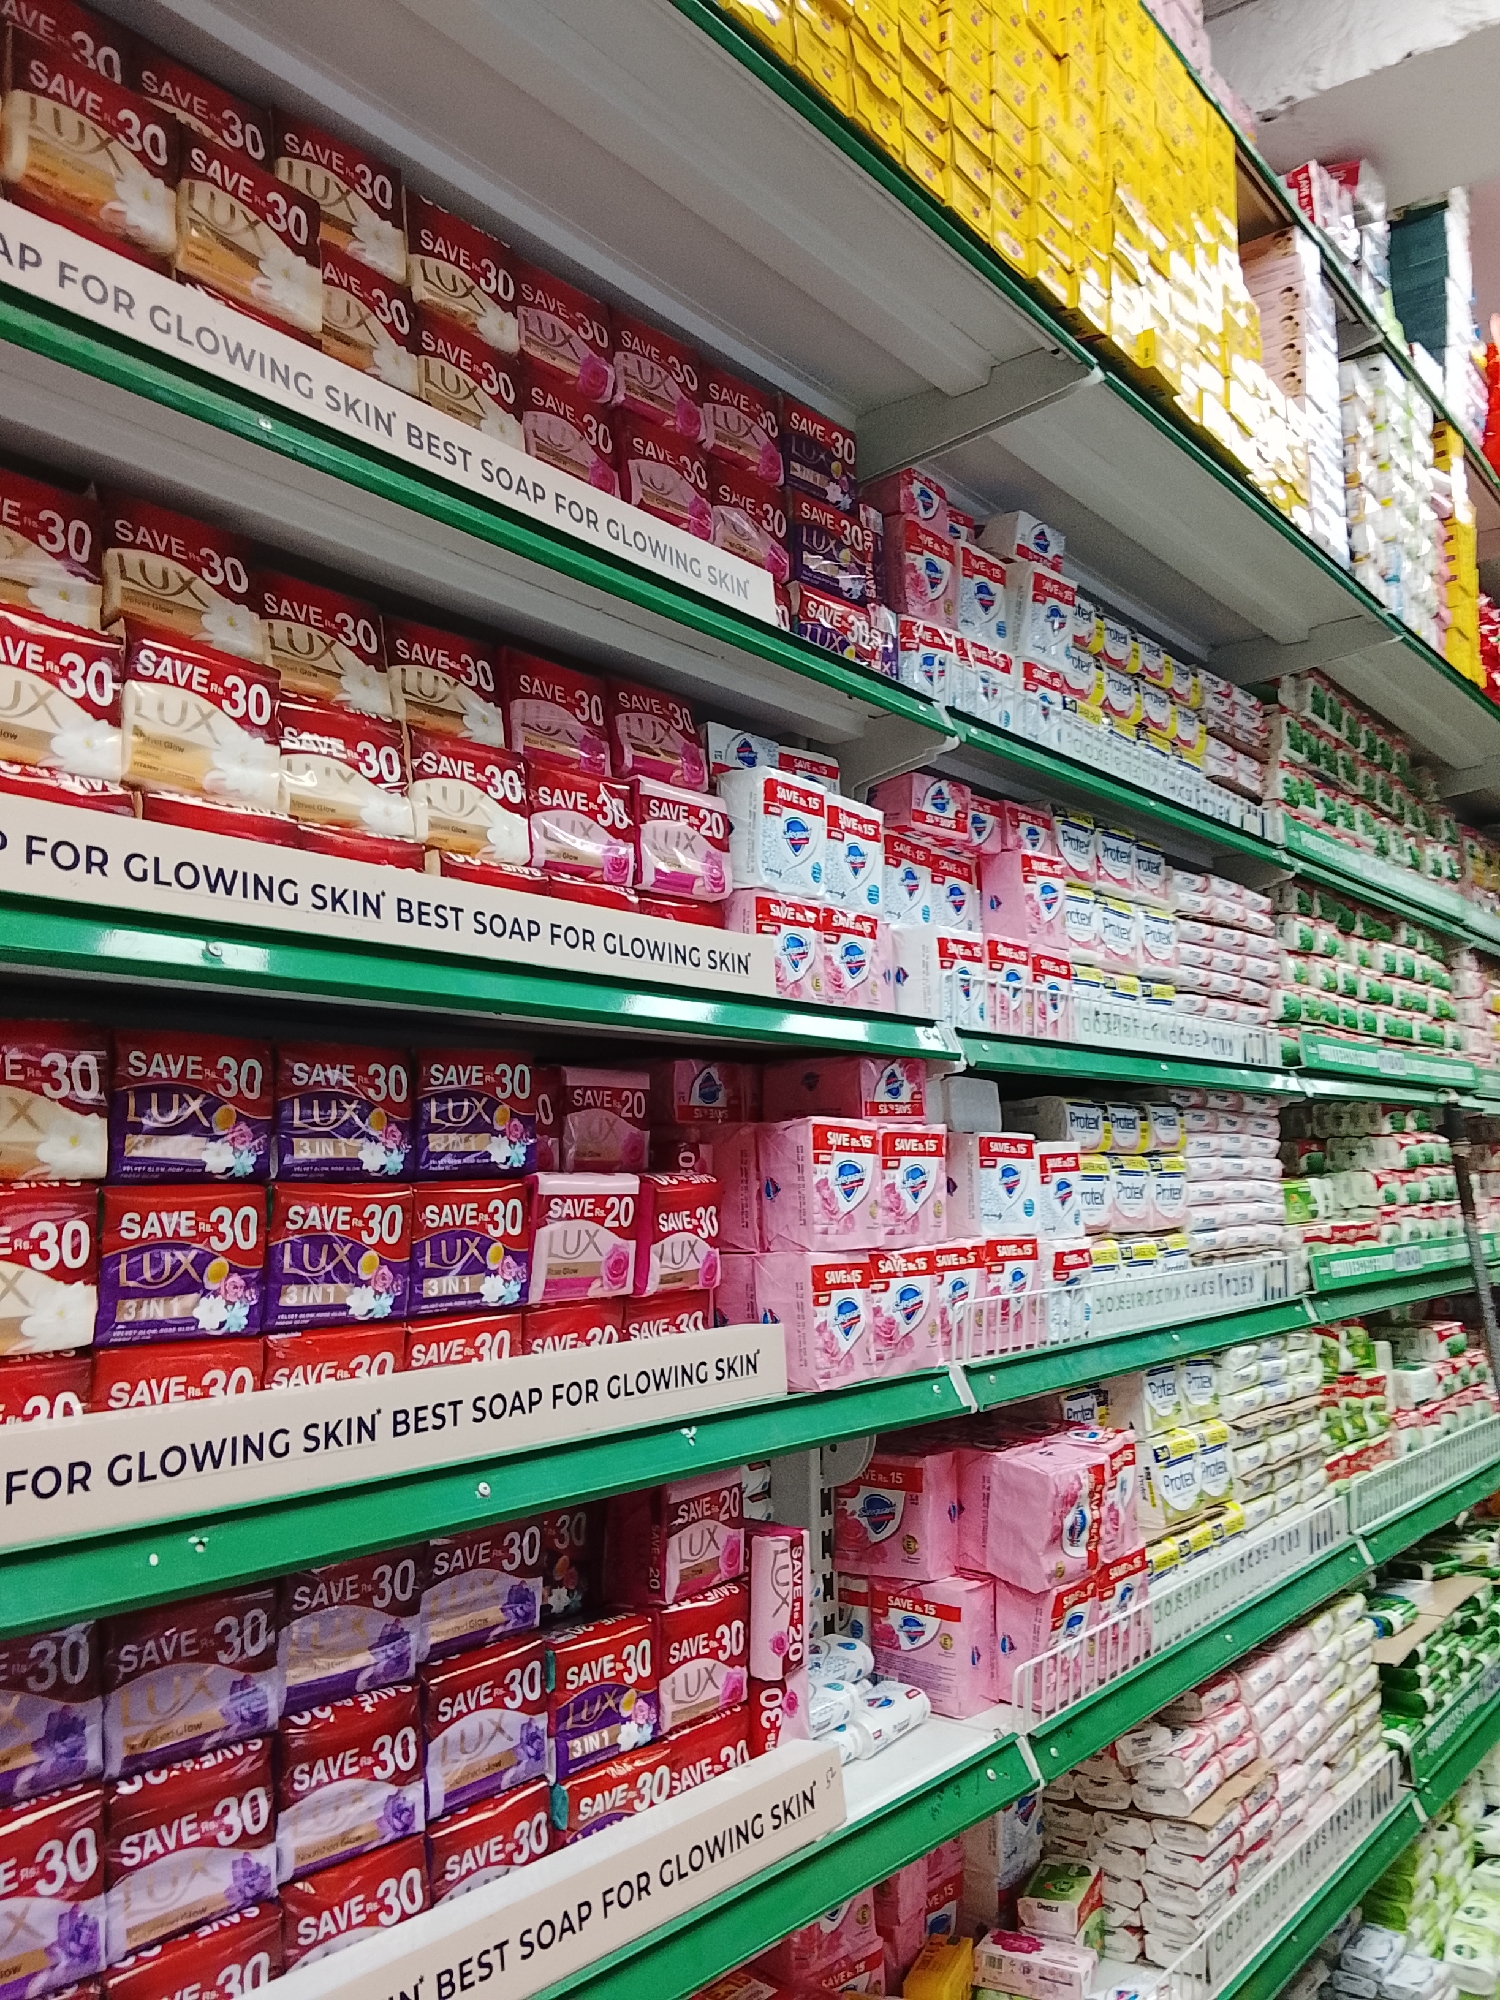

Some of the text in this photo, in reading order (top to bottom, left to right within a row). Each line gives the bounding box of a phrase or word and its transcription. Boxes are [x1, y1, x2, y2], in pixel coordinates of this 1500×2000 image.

[30, 60, 167, 165] SAVE 30
[142, 70, 265, 160] SAVE 30
[283, 132, 393, 211] SAVE 30
[190, 148, 308, 245] SAVE 30
[420, 229, 514, 302] SAVE 30
[420, 259, 487, 317] LUX
[421, 330, 516, 404] SAVE 30
[0, 233, 42, 271] AP
[58, 260, 135, 321] FOR
[150, 305, 314, 399] GLOWING
[406, 423, 472, 472] BEST
[481, 459, 546, 504] SOAP
[555, 493, 599, 533] FOR
[607, 518, 702, 579] GLOWING
[790, 412, 856, 465] SAVE 30
[800, 502, 863, 551] SAVE 30
[115, 519, 248, 594] SAVE 30
[116, 553, 209, 608] LUX
[264, 593, 377, 654] SAVE 30
[268, 622, 344, 671] LUX
[138, 650, 210, 693] SAVE
[221, 676, 271, 726] 30
[422, 752, 521, 803] SAVE 30
[777, 786, 820, 810] SAVE 15
[649, 800, 724, 839] SAVE 20
[839, 812, 875, 836] SAVE 15
[25, 834, 109, 877] FOR
[124, 852, 299, 906] GLOWING
[396, 898, 464, 931] BEST
[473, 912, 541, 943] SOAP
[550, 924, 596, 952] FOR
[603, 932, 700, 967] GLOWING
[770, 904, 795, 919] SAVE
[128, 1051, 262, 1100] SAVE 30
[291, 1062, 408, 1103] SAVE 30
[430, 1063, 531, 1100] SAVE 30
[127, 1092, 212, 1128] LUX
[292, 1098, 369, 1131] LUX
[430, 1097, 492, 1127] LUX
[572, 1087, 645, 1118] SAVE 20
[827, 1132, 873, 1148] SAVE 15
[895, 1138, 938, 1152] SAVE 15
[990, 1142, 1028, 1154] SAVE 15
[425, 1199, 523, 1237] SAVE 30
[549, 1197, 634, 1228] SAVE 20
[1081, 1188, 1105, 1206] rotex
[120, 1210, 196, 1240] SAVE
[209, 1206, 258, 1251] 30
[286, 1204, 404, 1245] SAVE 30
[658, 1206, 719, 1239] SAVE 30
[29, 1220, 90, 1271] 30
[282, 1242, 356, 1277] LUX
[425, 1237, 489, 1270] LUX
[878, 1258, 928, 1273] SAVE 15
[936, 1254, 959, 1267] SAVE
[119, 1249, 202, 1289] LUX
[428, 1279, 439, 1296] 3
[441, 1279, 461, 1295] IN
[825, 1270, 847, 1285] SAVE
[5, 1460, 92, 1506] FOR
[108, 1429, 290, 1486] GLOWING
[392, 1400, 463, 1438] BEST
[472, 1388, 542, 1423] SOAP
[553, 1379, 598, 1409] FOR
[607, 1362, 708, 1398] GLOWING
[890, 1472, 905, 1484] 15
[1164, 1466, 1197, 1494] Protex
[678, 1487, 739, 1522] SAVE 20
[433, 1526, 541, 1577] SAVE 30
[293, 1557, 415, 1612] SAVE 30
[887, 1596, 936, 1616] SAVE 15
[118, 1607, 275, 1673] SAVE 30
[669, 1630, 745, 1664] SAVE 30
[566, 1639, 651, 1692] SAVE 30
[437, 1683, 494, 1723] SAVE
[503, 1660, 542, 1709] 30
[293, 1753, 360, 1792] SAVE
[372, 1726, 417, 1780] 30
[120, 1811, 201, 1867] SAVE
[213, 1787, 269, 1846] 30
[444, 1812, 548, 1882] SAVE 30
[35, 1827, 98, 1896] 30
[297, 1868, 424, 1946] SAVE 30
[436, 1939, 509, 2000] BEST
[520, 1902, 593, 1961] SOAP
[603, 1872, 651, 1919] FOR
[659, 1814, 765, 1888] GLOWING
[822, 1962, 865, 1989] SAVE 15
